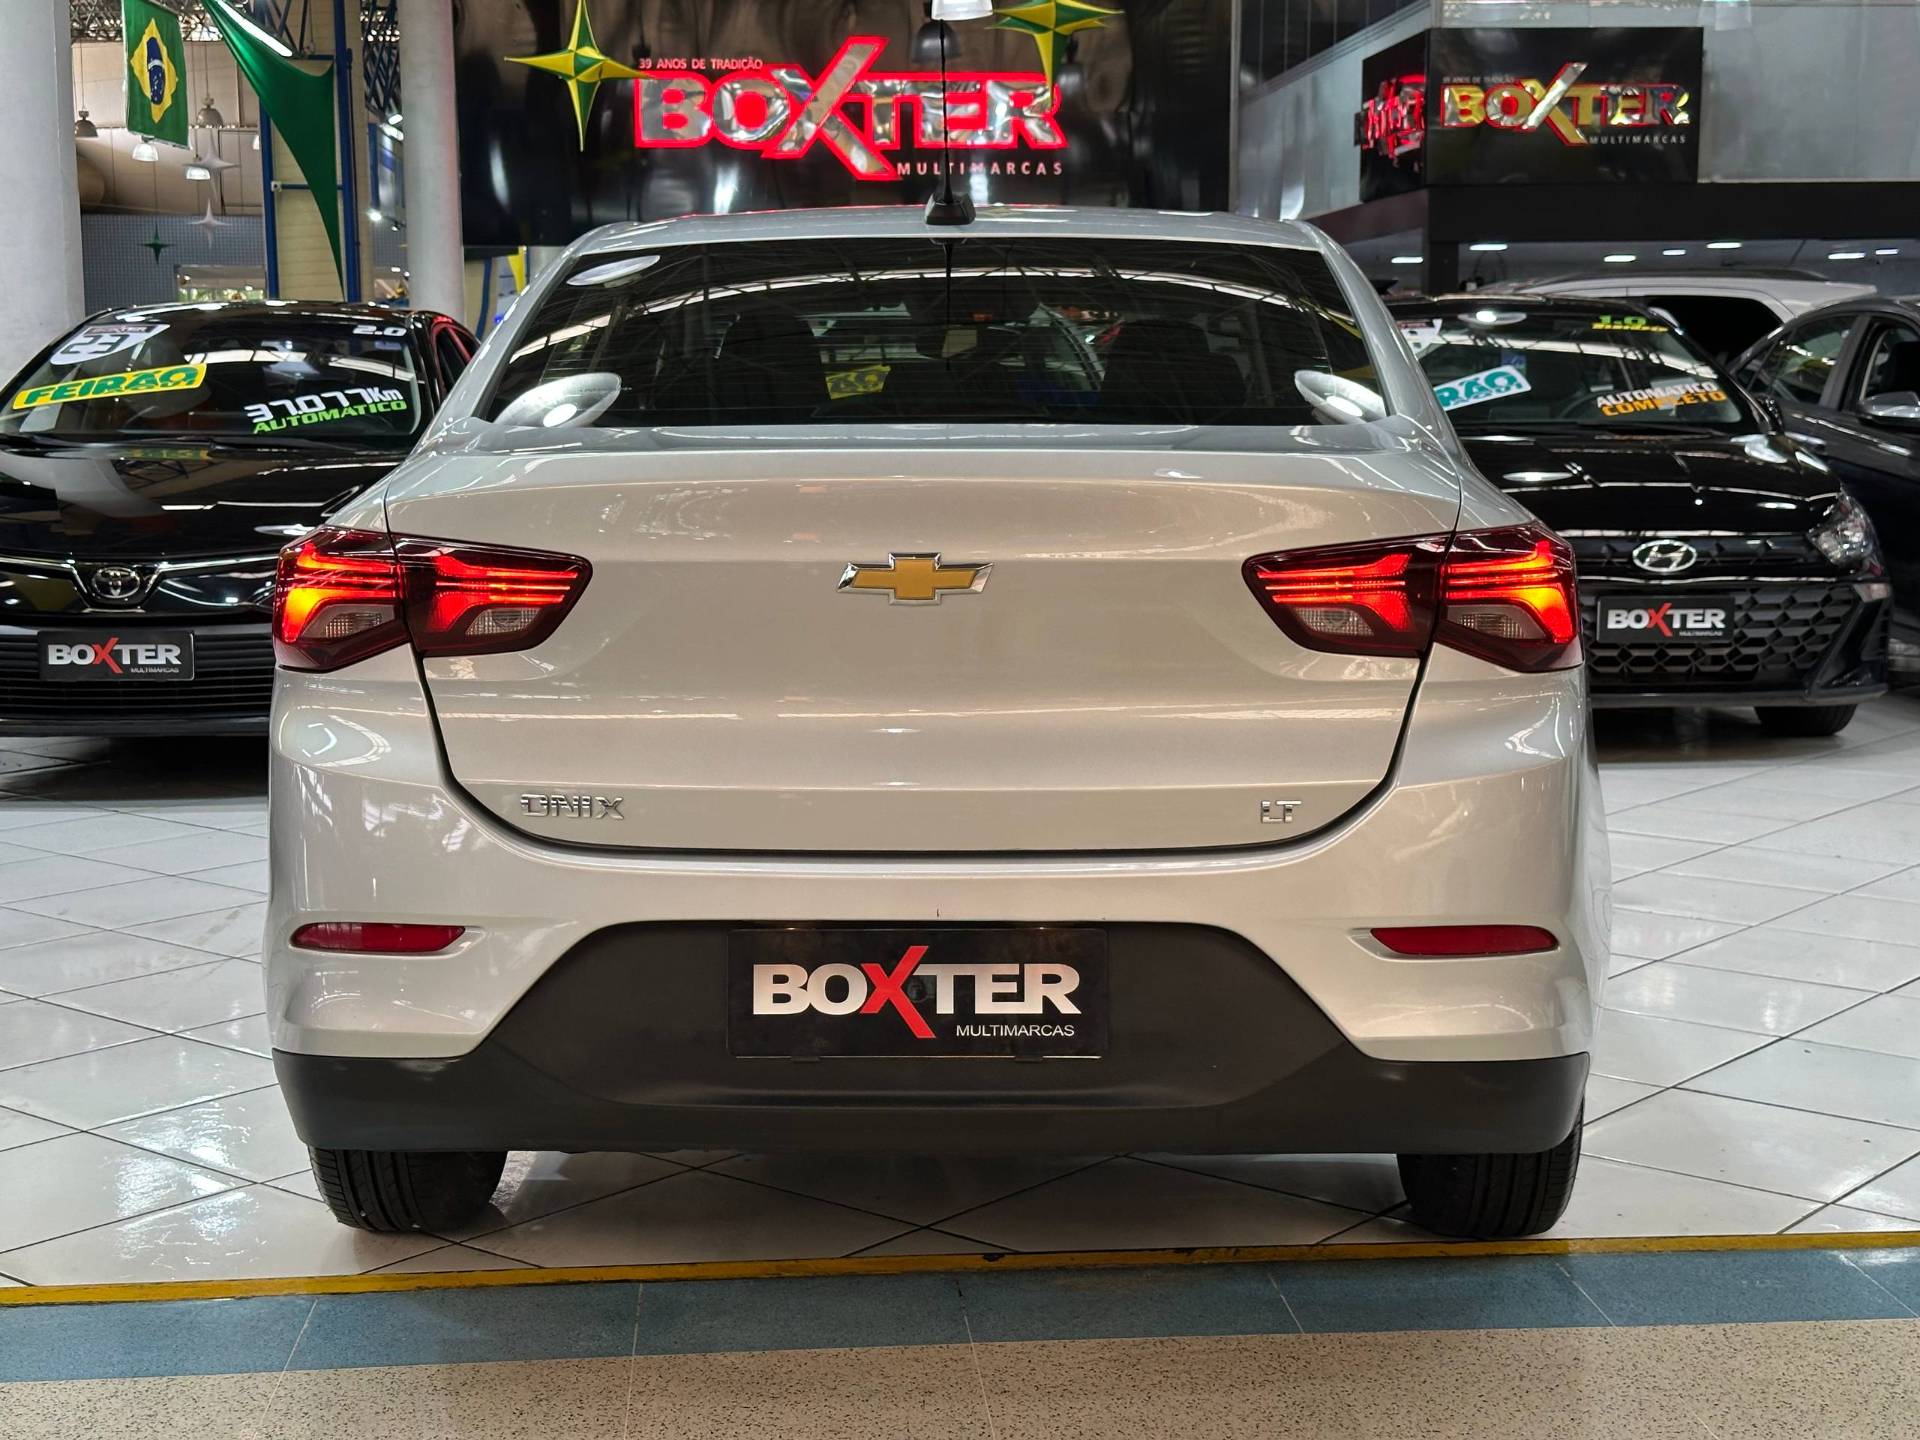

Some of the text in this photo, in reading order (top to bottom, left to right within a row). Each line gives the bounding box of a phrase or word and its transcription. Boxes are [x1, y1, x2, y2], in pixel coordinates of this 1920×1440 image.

[639, 56, 763, 71] 39 ANOS DE TRADIÇÃO
[635, 35, 1068, 181] BOXTER
[1440, 61, 1690, 146] BOXTER
[1589, 135, 1687, 145] MULTIMARCAS
[897, 162, 1063, 175] MULTIMARCAS
[353, 324, 407, 337] 2.0
[60, 333, 131, 355] 23
[1607, 602, 1726, 637] BOXTER
[48, 637, 182, 674] BOXTER
[520, 793, 624, 820] ONIX
[1261, 800, 1302, 823] LT
[753, 945, 1082, 1039] BOXTER
[956, 1024, 1075, 1037] MULTIMARCAS
